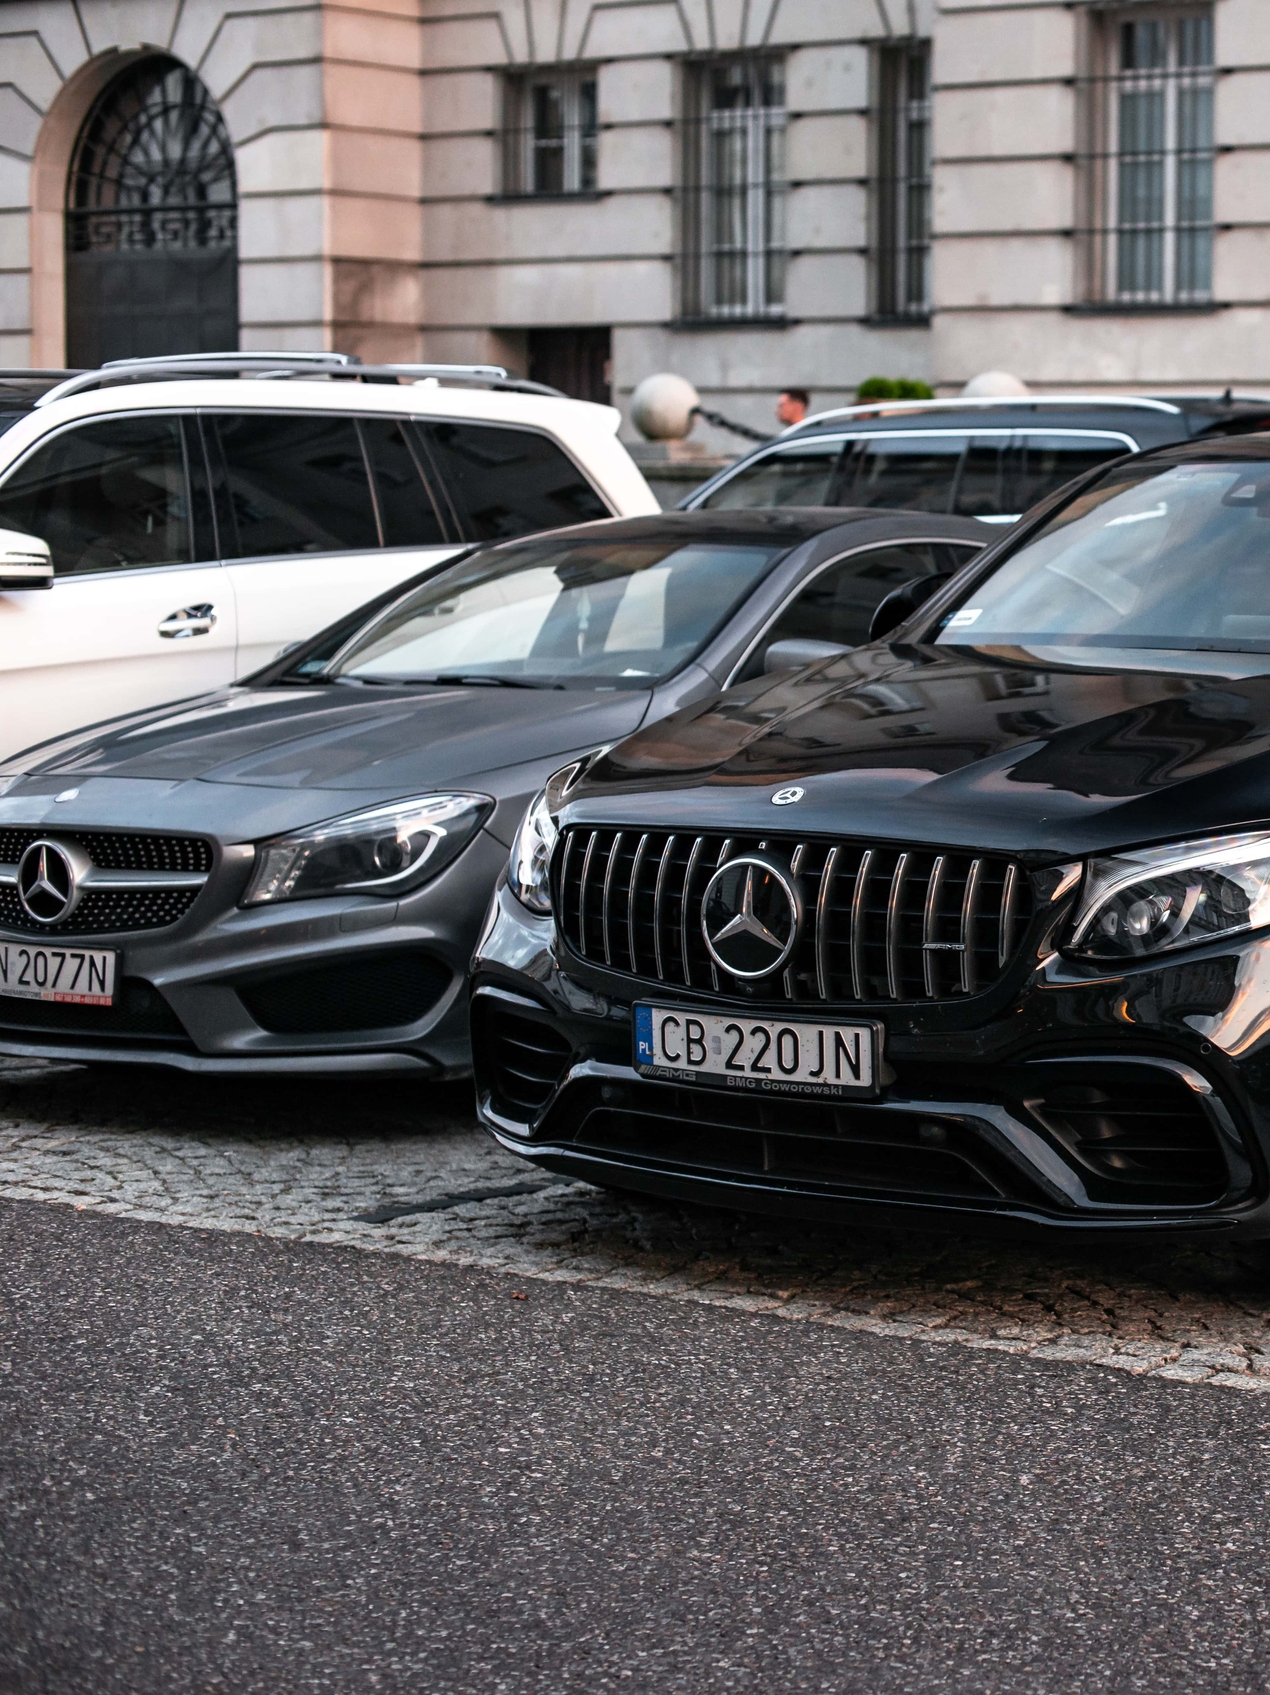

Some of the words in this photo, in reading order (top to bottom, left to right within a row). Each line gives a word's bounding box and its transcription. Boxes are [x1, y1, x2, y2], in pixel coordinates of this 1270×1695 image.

[18, 949, 107, 993] 2077N
[639, 1041, 650, 1055] PL
[661, 1015, 708, 1066] CB
[656, 1067, 697, 1082] AMG
[726, 1076, 756, 1088] BMG
[761, 1079, 843, 1096] Goworowski
